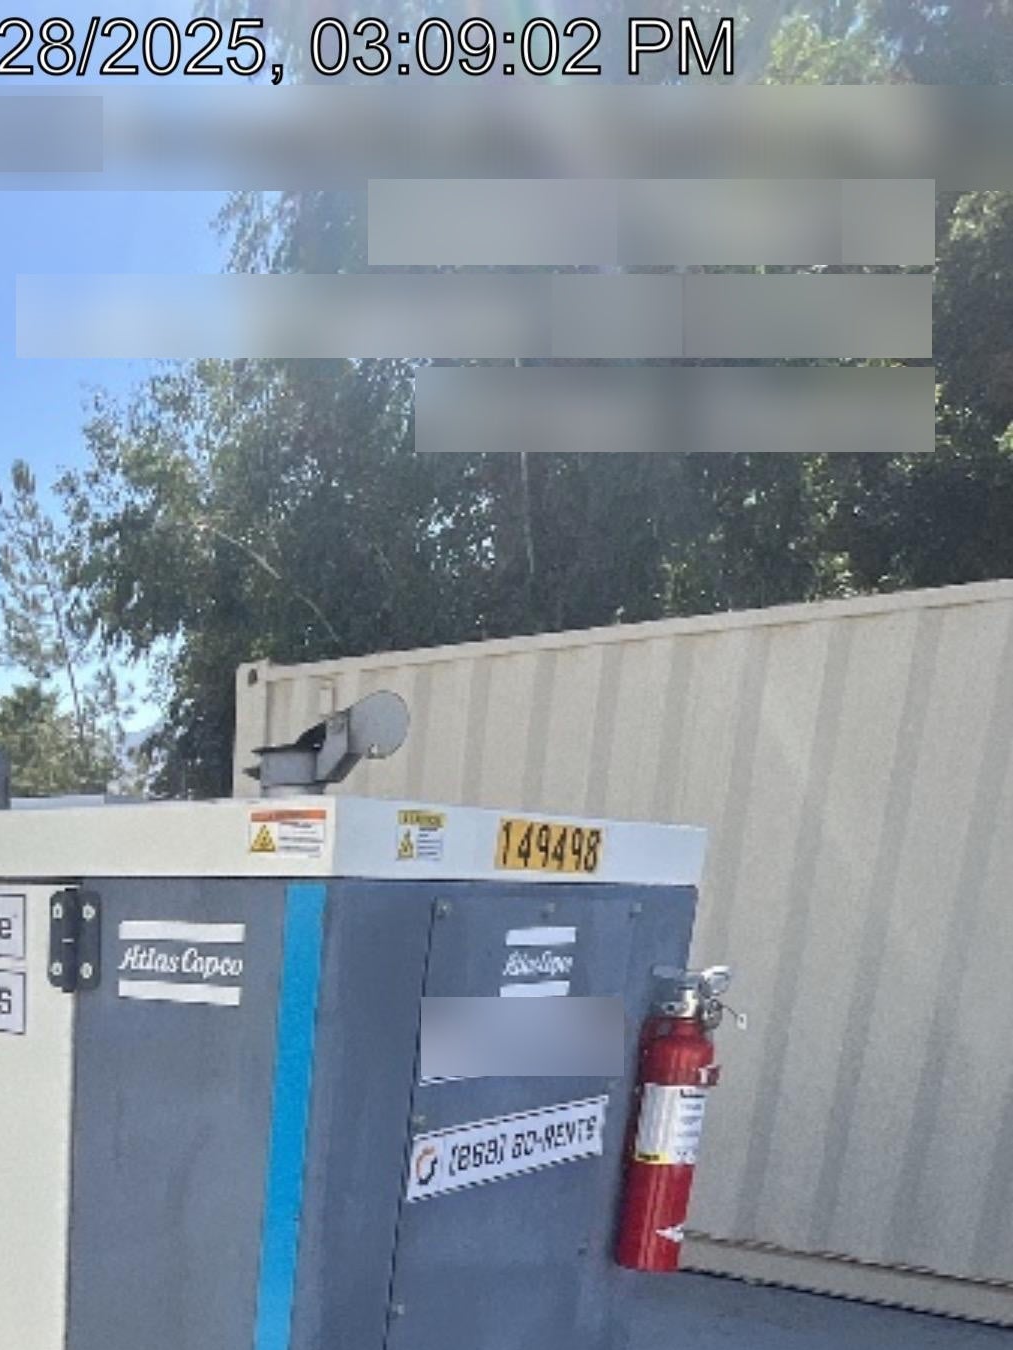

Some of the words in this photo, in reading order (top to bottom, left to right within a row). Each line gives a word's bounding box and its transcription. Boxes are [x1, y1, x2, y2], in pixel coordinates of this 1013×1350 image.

[501, 820, 601, 873] 149498
[117, 944, 180, 973] Atlas
[181, 947, 243, 979] Copco
